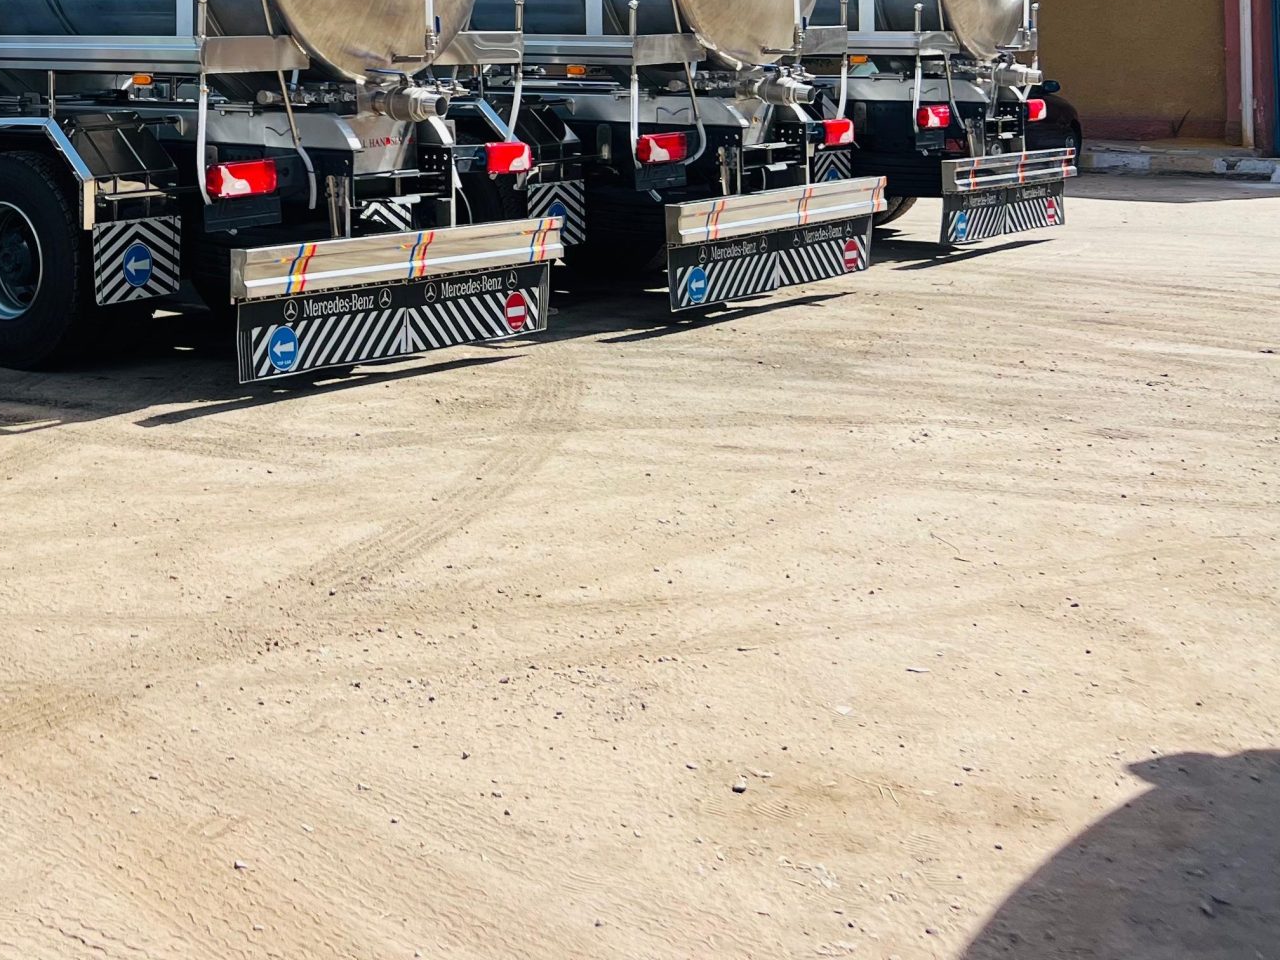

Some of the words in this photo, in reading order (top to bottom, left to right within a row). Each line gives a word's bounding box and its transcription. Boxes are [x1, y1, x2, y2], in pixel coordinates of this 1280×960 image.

[803, 225, 843, 244] Mercedes-Benz
[710, 241, 757, 261] Mercedes-Benz
[440, 275, 502, 299] Mercedes-Benz
[303, 293, 375, 317] Mercedes-Benz
